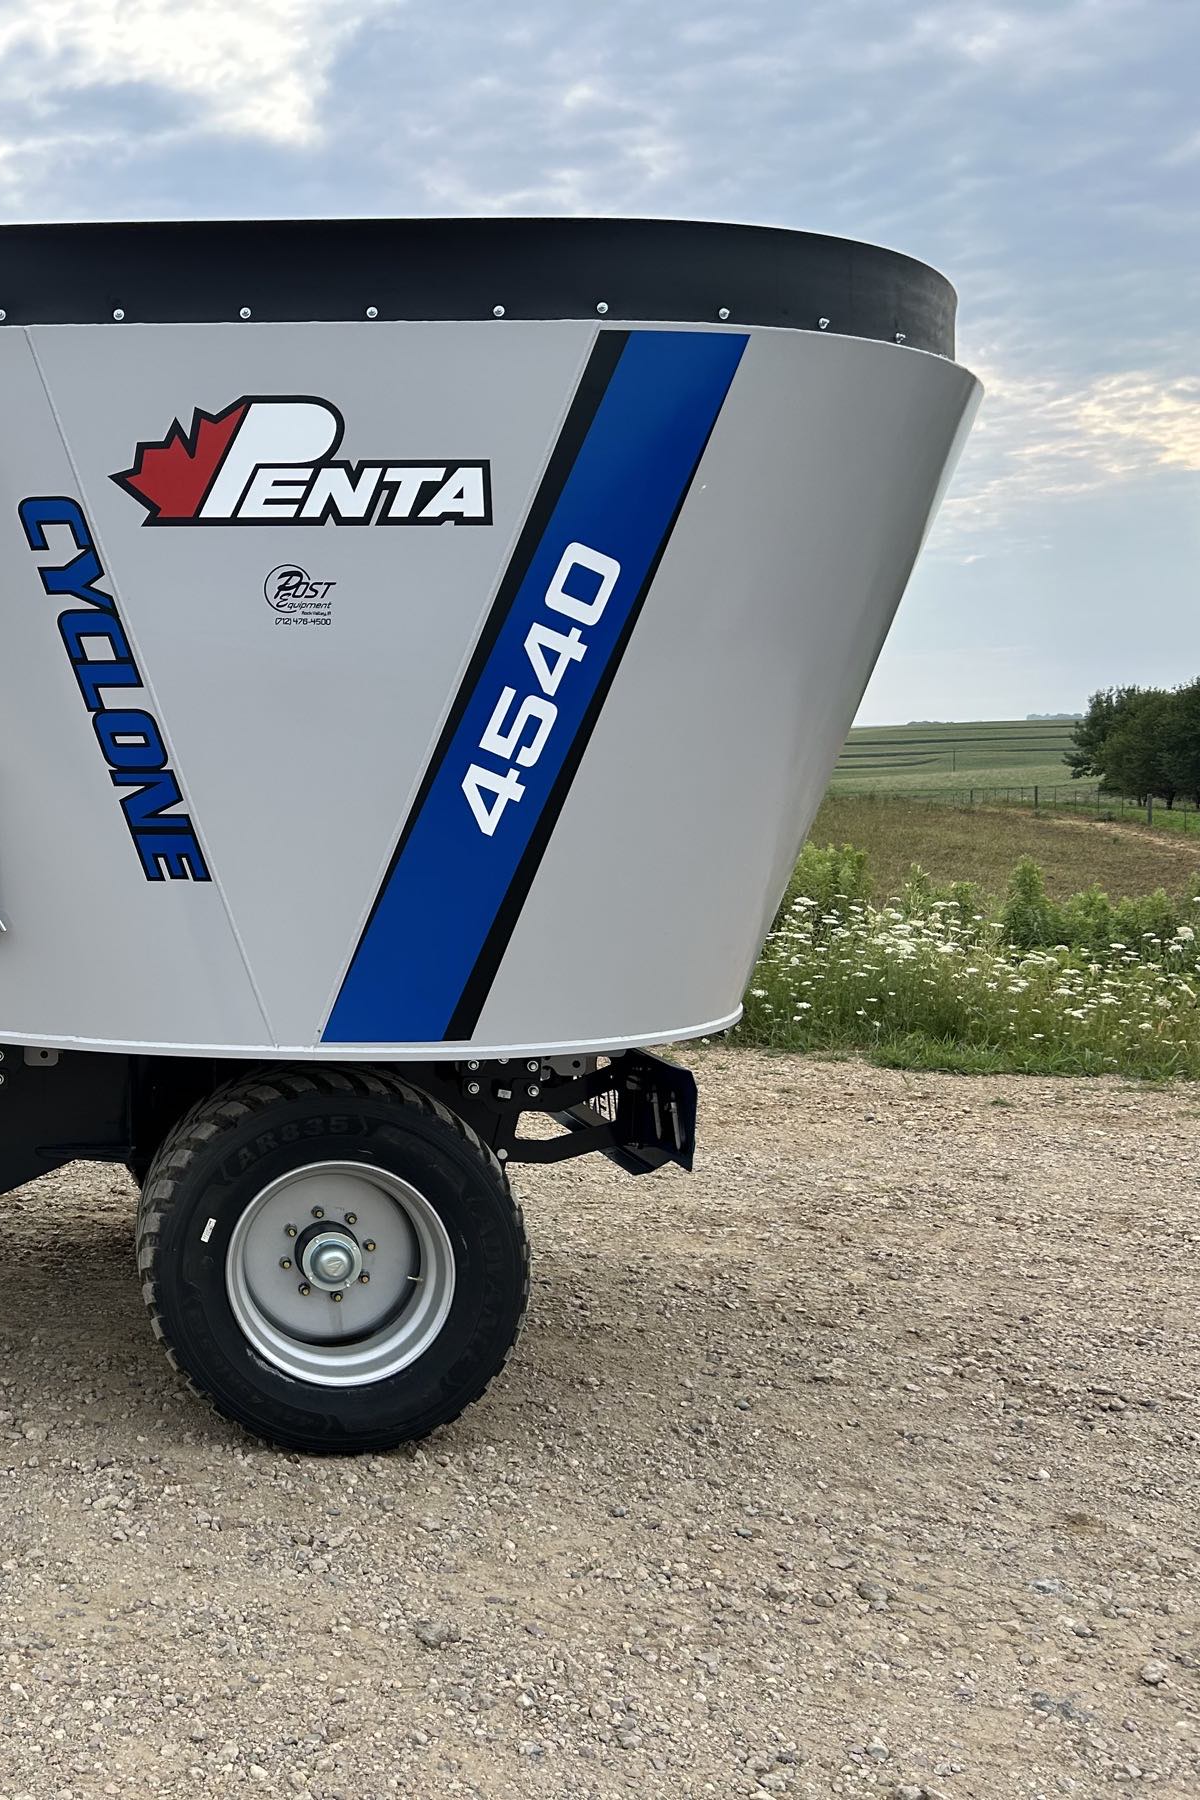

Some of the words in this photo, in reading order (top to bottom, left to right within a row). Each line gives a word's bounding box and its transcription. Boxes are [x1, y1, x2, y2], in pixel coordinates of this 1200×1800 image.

[194, 395, 493, 525] PENTA
[274, 570, 337, 599] POST
[276, 593, 332, 610] Equipment
[275, 618, 292, 626] (712)
[18, 496, 212, 881] CYCLONE
[461, 542, 621, 837] 4540
[238, 1115, 349, 1171] AR835
